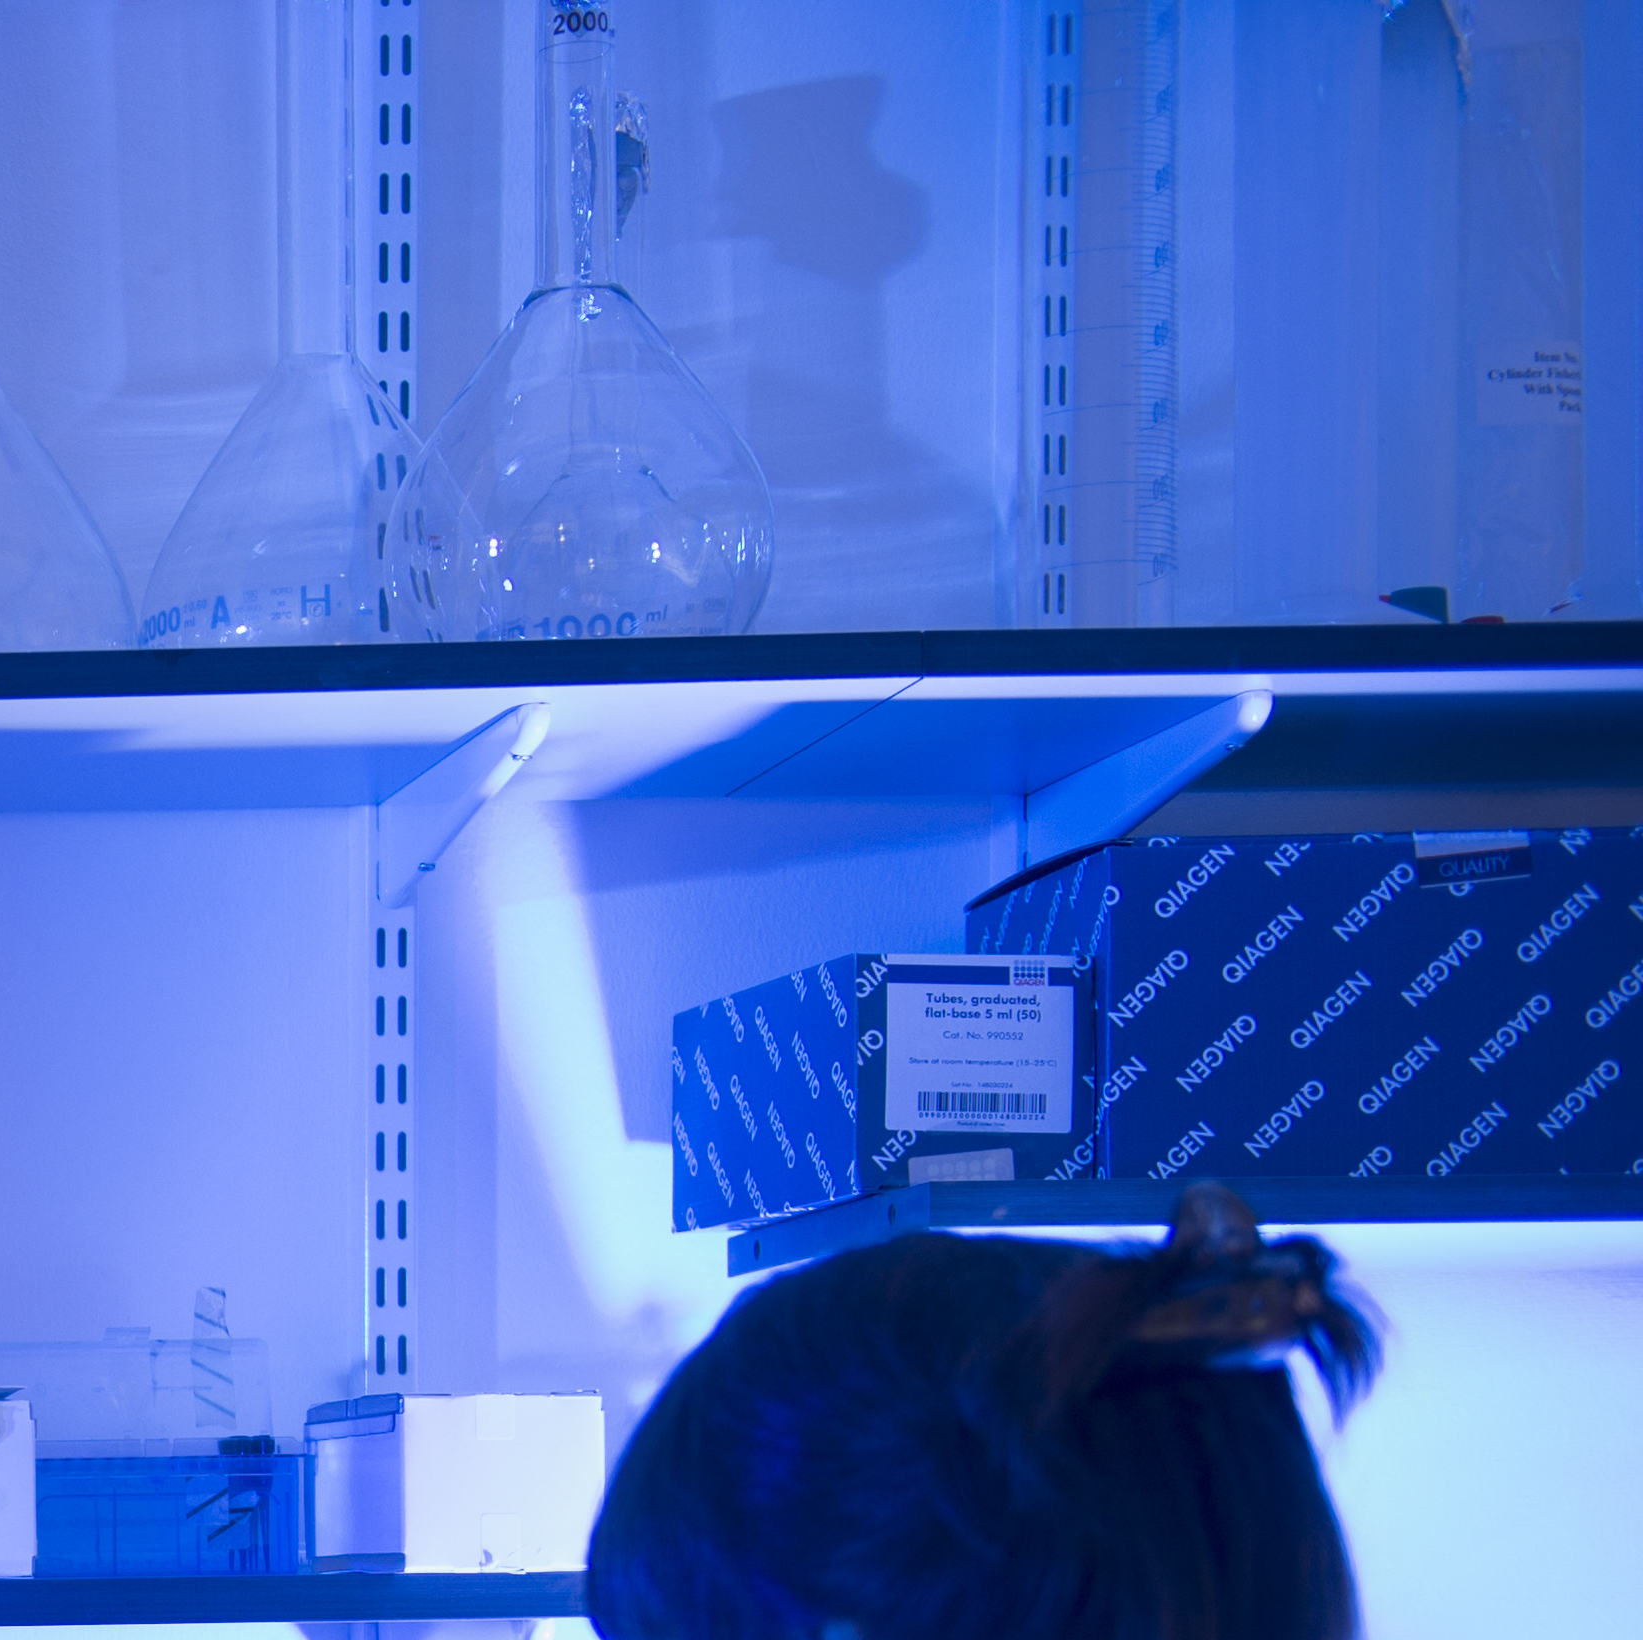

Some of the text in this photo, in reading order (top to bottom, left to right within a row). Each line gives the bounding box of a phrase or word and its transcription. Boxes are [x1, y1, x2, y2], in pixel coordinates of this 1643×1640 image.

[553, 11, 608, 35] 2000
[211, 595, 231, 630] A
[300, 584, 331, 617] H
[532, 604, 668, 640] 1000 ml
[1154, 843, 1237, 919] QIAGEN
[1439, 855, 1511, 878] QUALITY
[1332, 862, 1415, 943] QIAGEN
[1517, 882, 1601, 964] QIAGEN
[1222, 904, 1306, 984] QIAGEN
[1400, 928, 1484, 1008] QIAGEN
[925, 1007, 1042, 1023] flat-base 5 ml (50)
[926, 992, 1041, 1007] Tubes, graduated,
[1107, 949, 1190, 1028] QIAGEN
[1289, 970, 1373, 1050] QIAGEN
[755, 1005, 782, 1073] QIAGEN
[909, 1056, 929, 1065] Store
[941, 1058, 963, 1066] room
[965, 1057, 1014, 1068] temperature
[942, 1030, 1024, 1041] Cat. No. 990552
[1175, 1014, 1259, 1093] QIAGEN
[1468, 994, 1553, 1074] QIAGEN
[730, 1074, 758, 1141] QIAGEN
[1358, 1035, 1441, 1115] QIAGEN
[1537, 1059, 1622, 1139] QIAGEN
[871, 1129, 917, 1172] GEN
[1148, 1120, 1215, 1180] IAGEN
[1243, 1080, 1326, 1158] QIAGEN
[1426, 1101, 1510, 1177] QIAGEN
[707, 1142, 735, 1208] QIAGEN
[805, 1132, 836, 1200] QIAGEN
